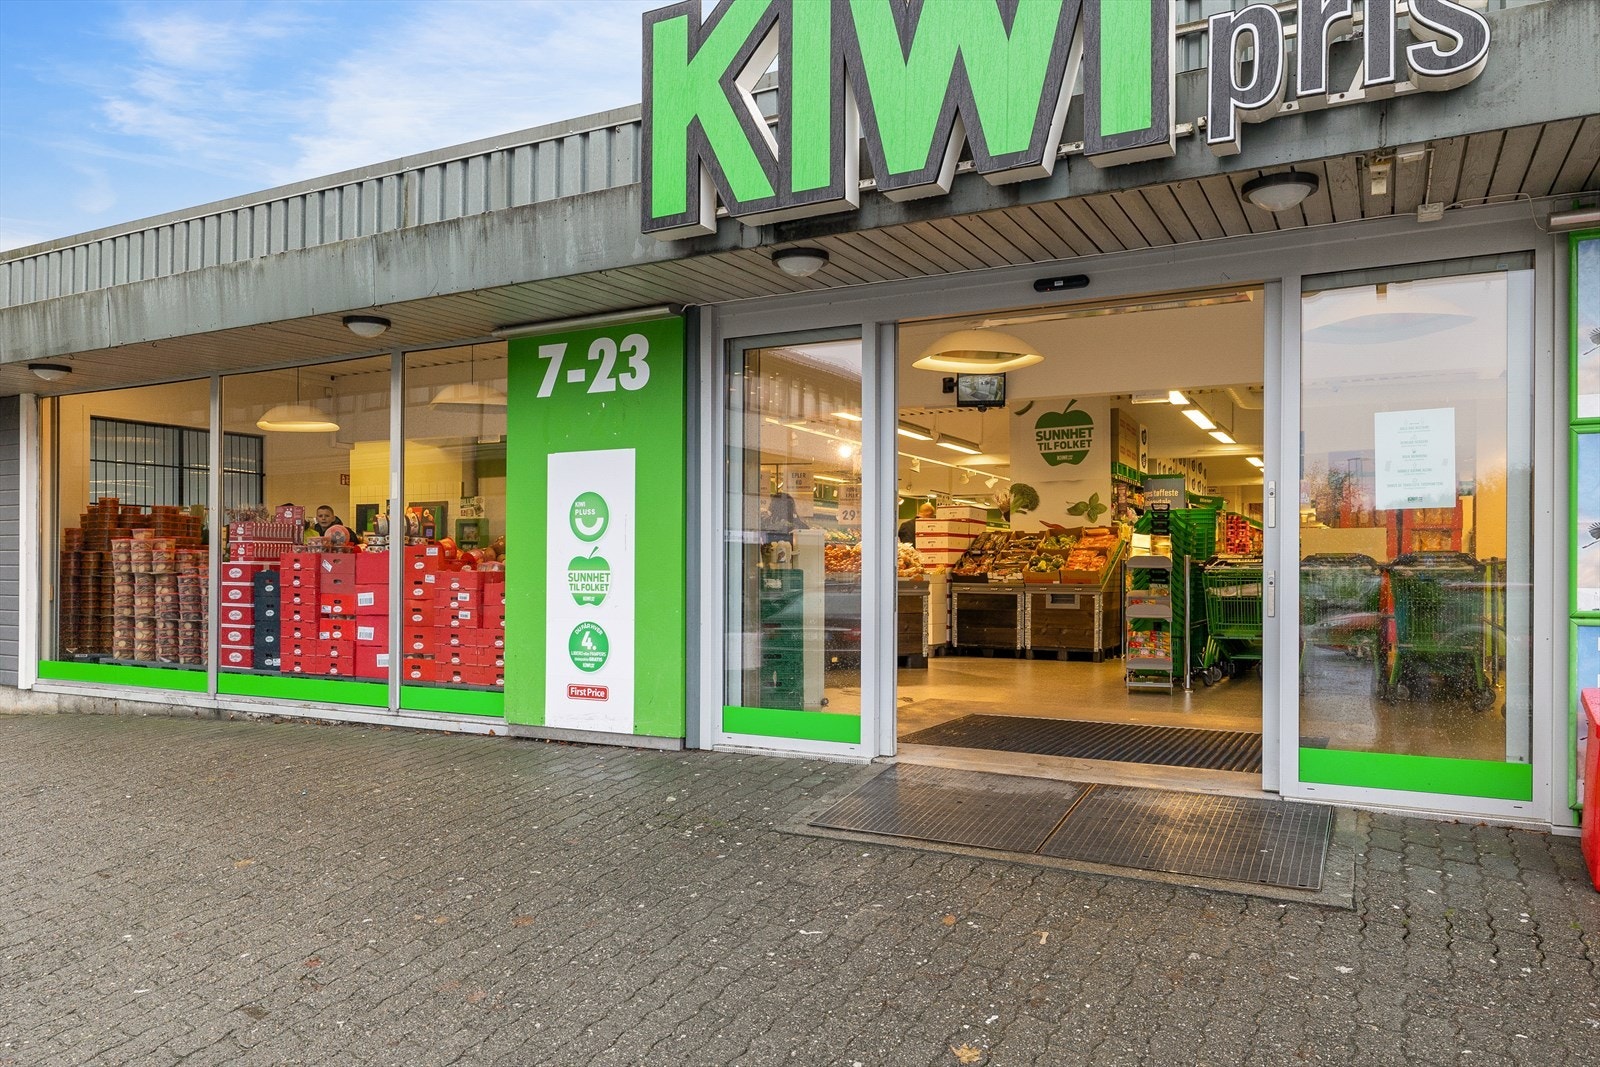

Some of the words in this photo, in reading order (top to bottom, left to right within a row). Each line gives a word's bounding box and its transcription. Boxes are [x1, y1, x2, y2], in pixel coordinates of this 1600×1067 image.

[1207, 0, 1492, 145] pris
[641, 0, 1176, 233] KIWI
[536, 333, 651, 398] 7-23
[1035, 427, 1094, 441] SUNNHET
[1037, 442, 1053, 451] TIL
[1053, 439, 1093, 450] FOLKET
[574, 508, 596, 516] PLUSS
[567, 572, 611, 583] SUNNHET
[568, 583, 581, 592] TIL
[580, 583, 610, 592] FOLKET
[581, 630, 598, 651] 4.
[570, 687, 587, 697] First
[586, 687, 606, 698] Price
